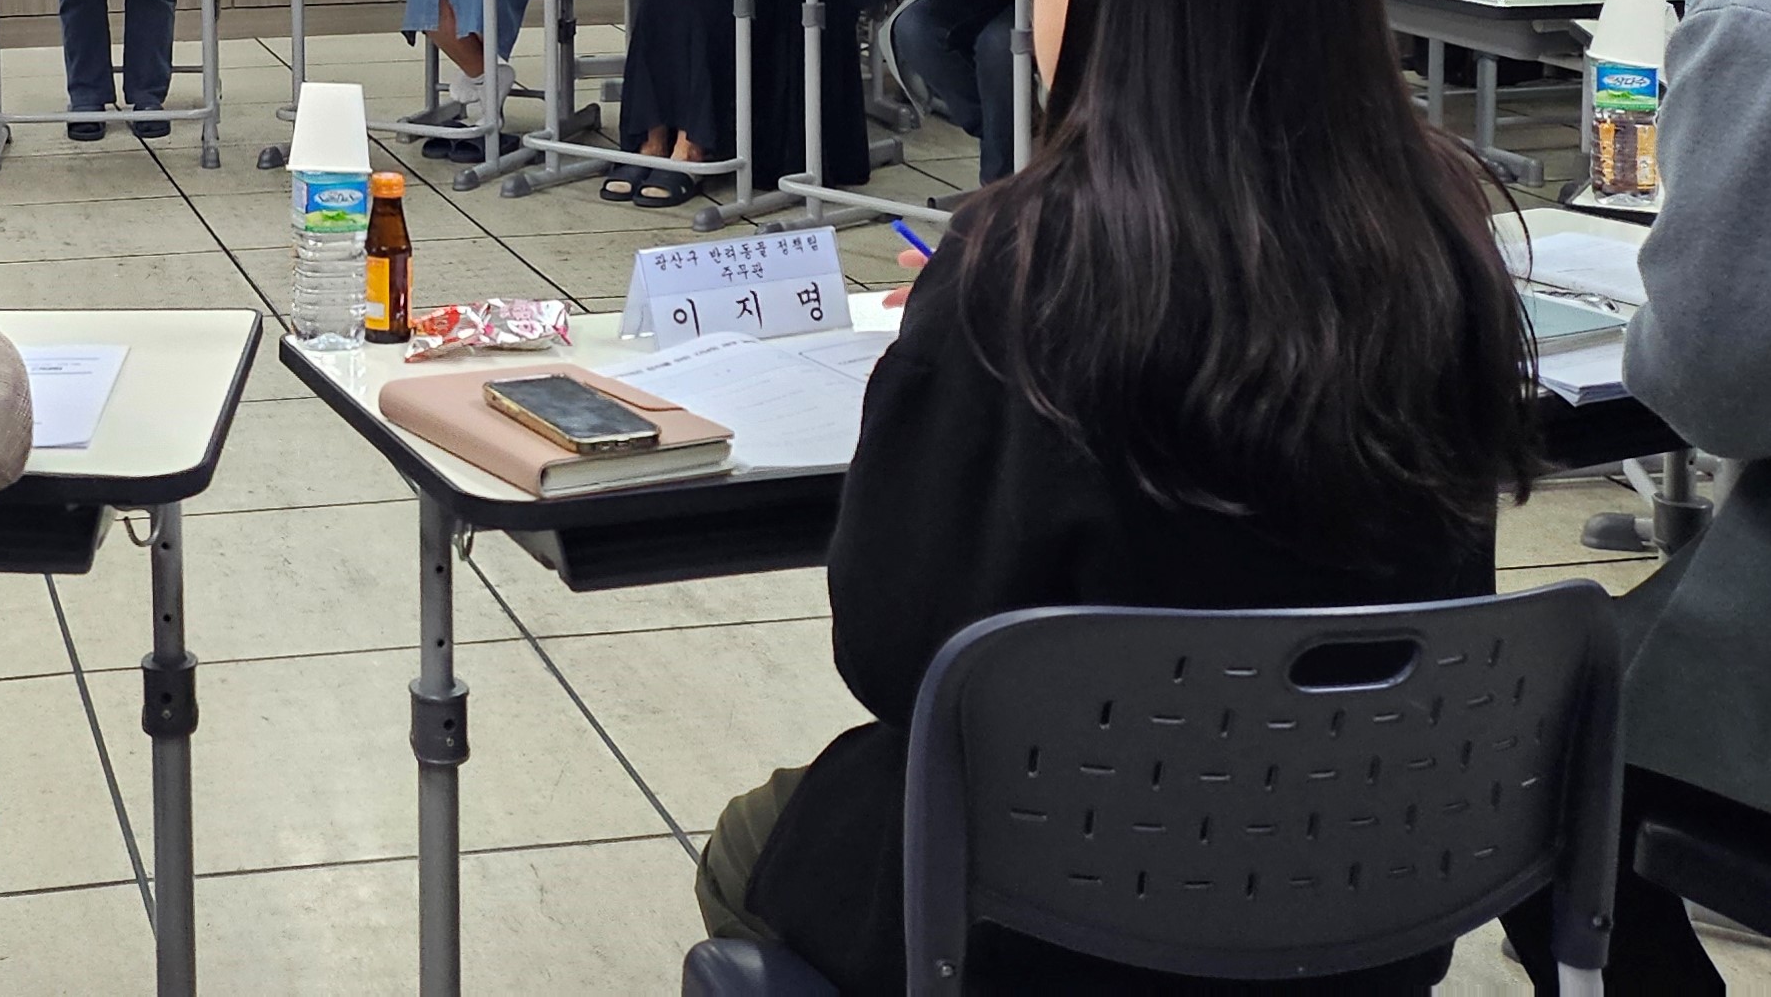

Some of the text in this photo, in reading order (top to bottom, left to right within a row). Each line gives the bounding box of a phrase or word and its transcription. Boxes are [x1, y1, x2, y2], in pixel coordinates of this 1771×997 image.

[655, 234, 819, 270] 광산구 반려동물 정책팀
[721, 263, 765, 282] 주무관
